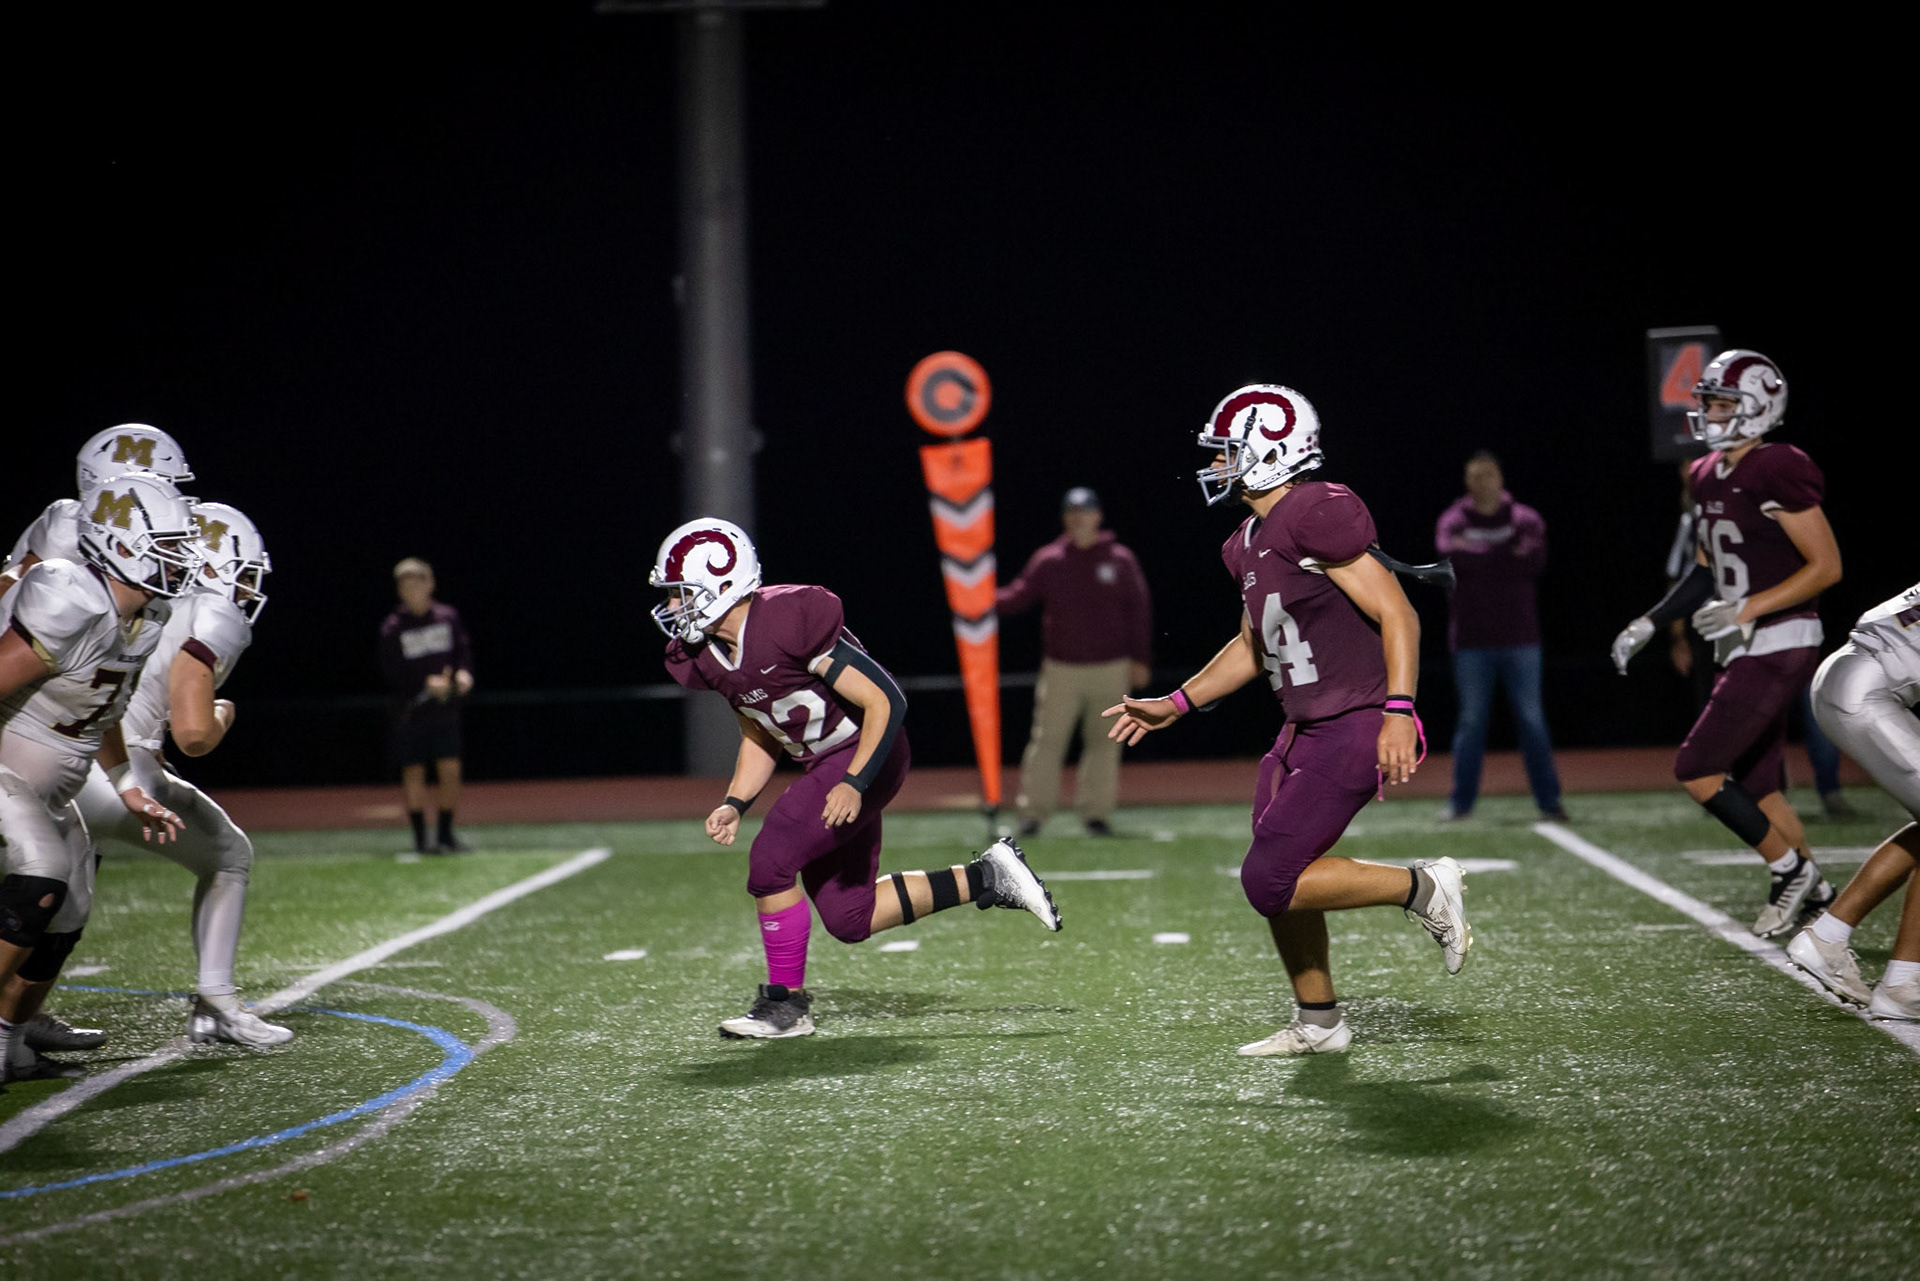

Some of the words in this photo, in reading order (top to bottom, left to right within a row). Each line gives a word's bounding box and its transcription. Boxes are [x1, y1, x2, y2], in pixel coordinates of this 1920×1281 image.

[1661, 344, 1704, 410] 4
[112, 435, 156, 468] M
[92, 490, 135, 530] M
[1698, 518, 1750, 604] 6
[1241, 592, 1319, 691] 4
[52, 667, 140, 739] 7
[739, 688, 769, 704] RAMS
